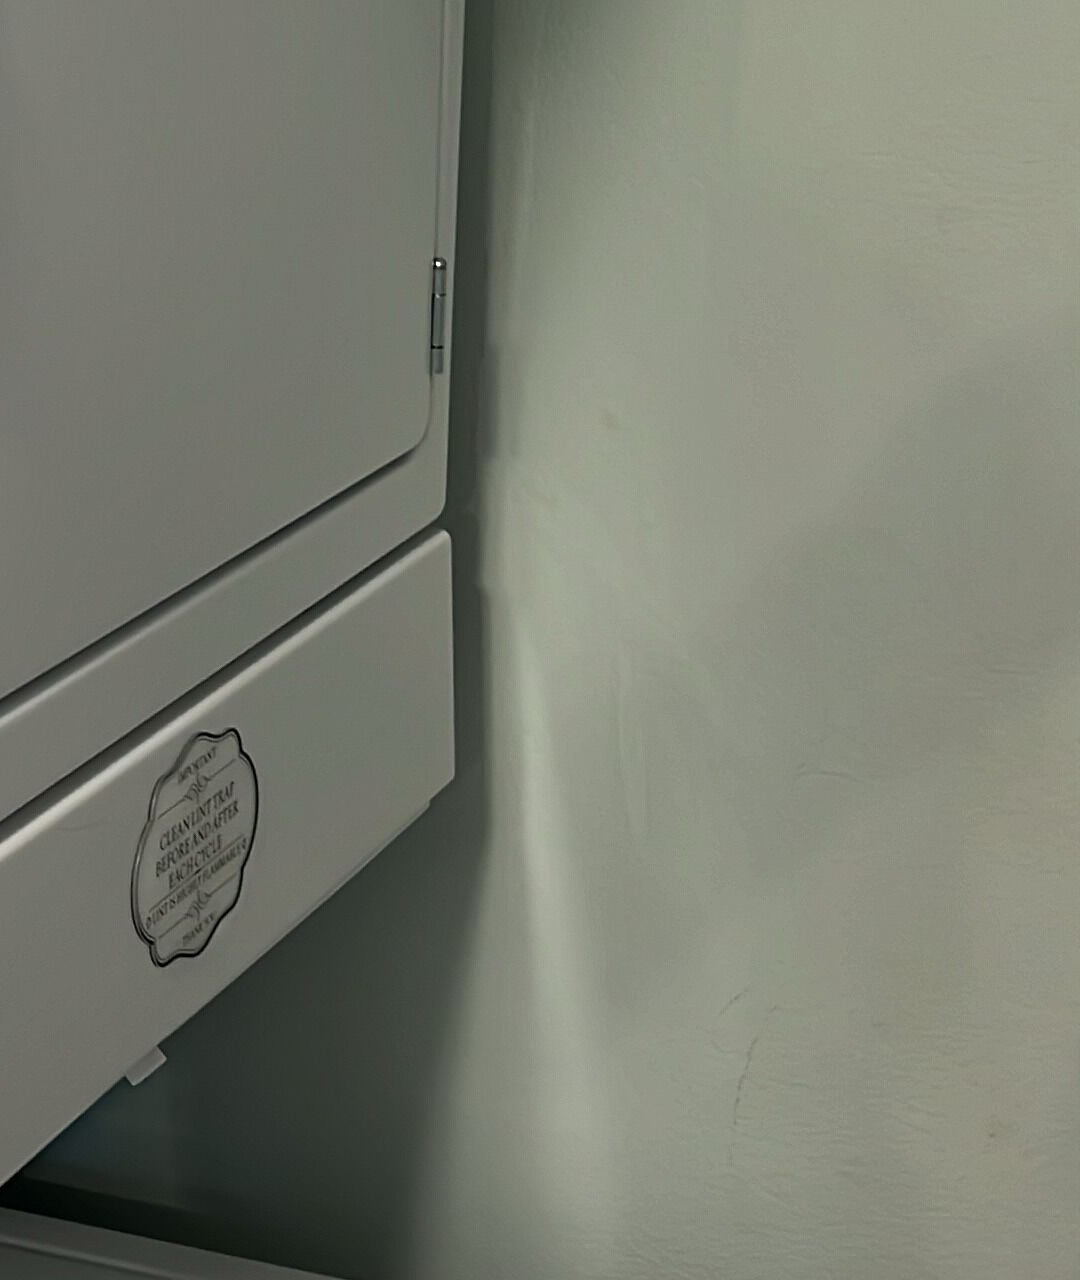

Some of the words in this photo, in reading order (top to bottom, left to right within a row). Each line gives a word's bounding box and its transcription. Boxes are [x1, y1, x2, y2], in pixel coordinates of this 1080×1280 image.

[156, 836, 190, 877] BEFORE
[191, 822, 211, 849] AND
[212, 800, 239, 832] AFTER
[160, 815, 190, 850] CLEAN
[191, 797, 212, 827] LINT
[212, 781, 235, 811] TRAP
[168, 856, 193, 889] EACH
[194, 834, 221, 867] CYCLE
